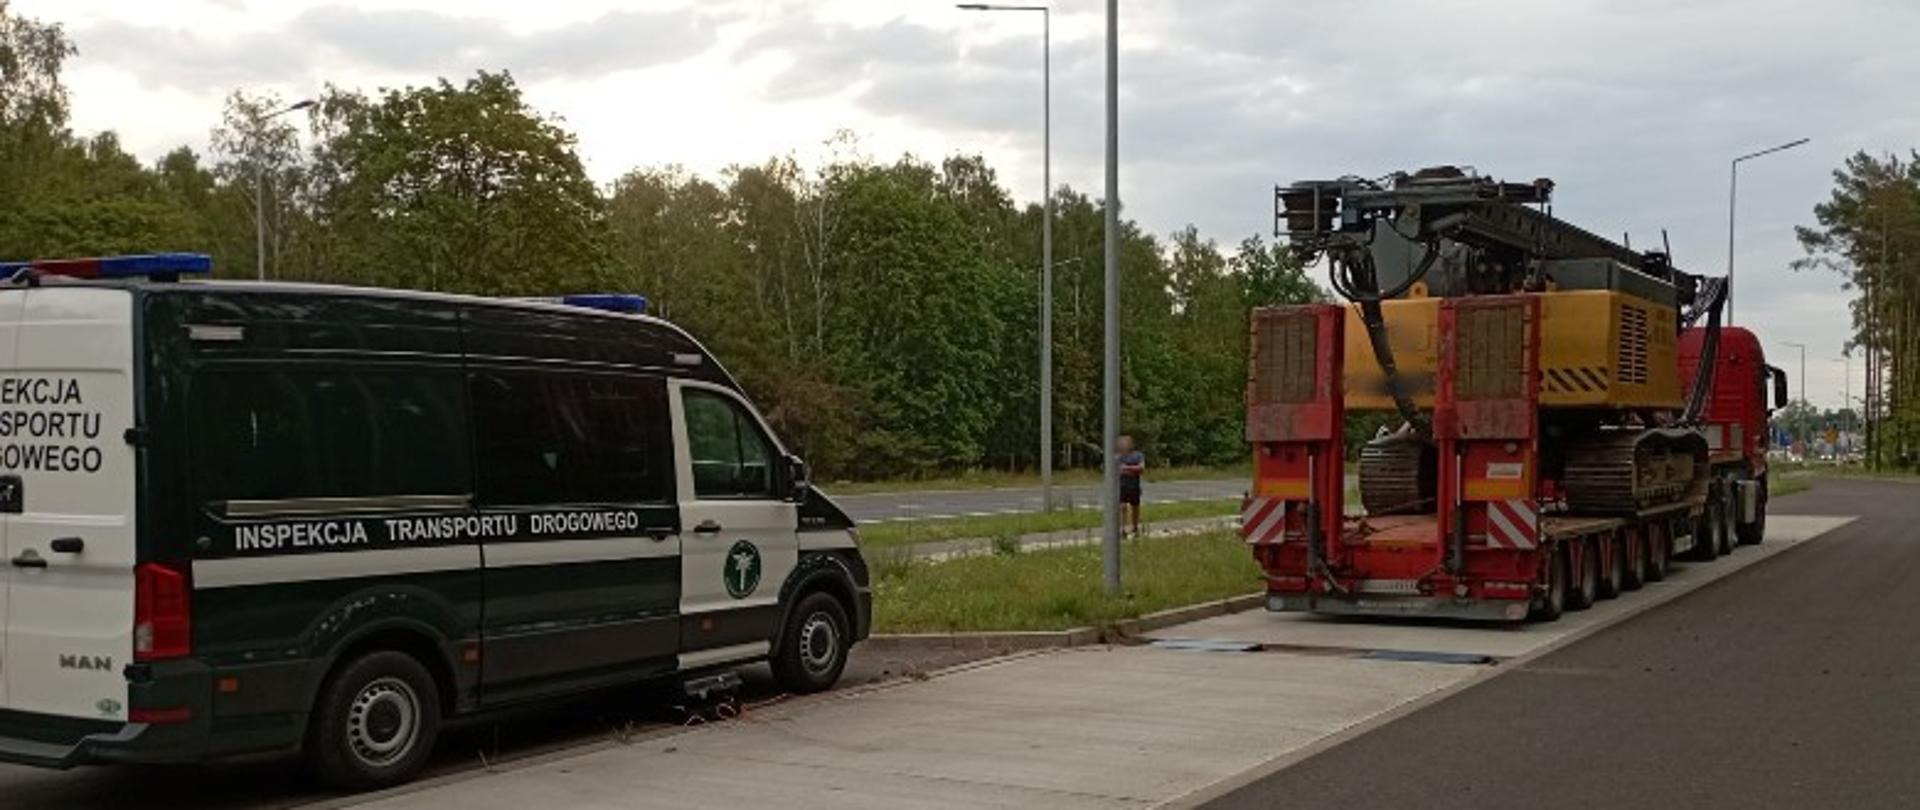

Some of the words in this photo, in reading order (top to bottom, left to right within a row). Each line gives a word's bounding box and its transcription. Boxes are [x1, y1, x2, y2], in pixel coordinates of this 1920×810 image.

[0, 443, 102, 473] OWEGO
[235, 520, 368, 550] INSPEKCJA
[385, 513, 518, 541] TRANSPORTU
[530, 511, 639, 534] DROGOWEGO
[59, 654, 112, 671] MAN
